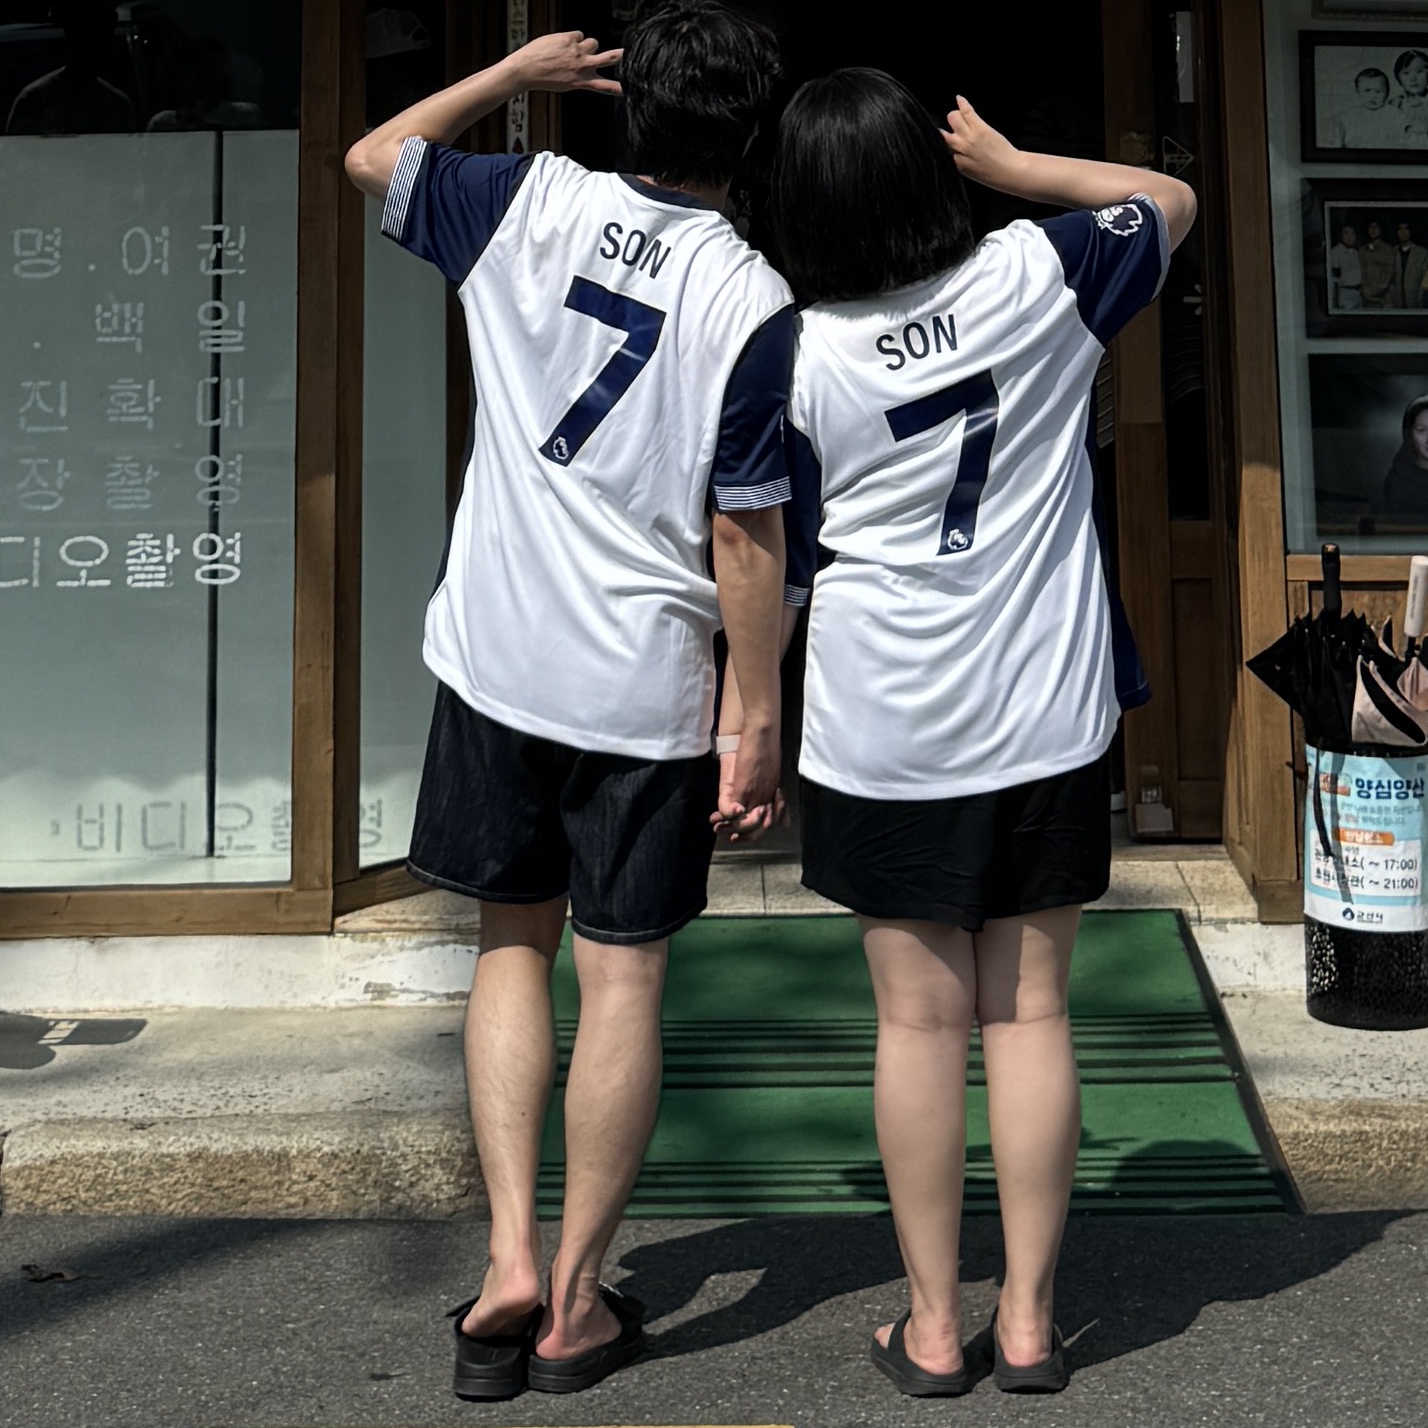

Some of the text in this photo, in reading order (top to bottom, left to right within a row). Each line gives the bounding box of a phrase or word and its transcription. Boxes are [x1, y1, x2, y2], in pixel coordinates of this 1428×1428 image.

[598, 220, 672, 280] SON
[537, 274, 667, 467] 7
[875, 312, 959, 371] SON
[884, 368, 1000, 556] 7
[1355, 776, 1425, 800] 양심양산
